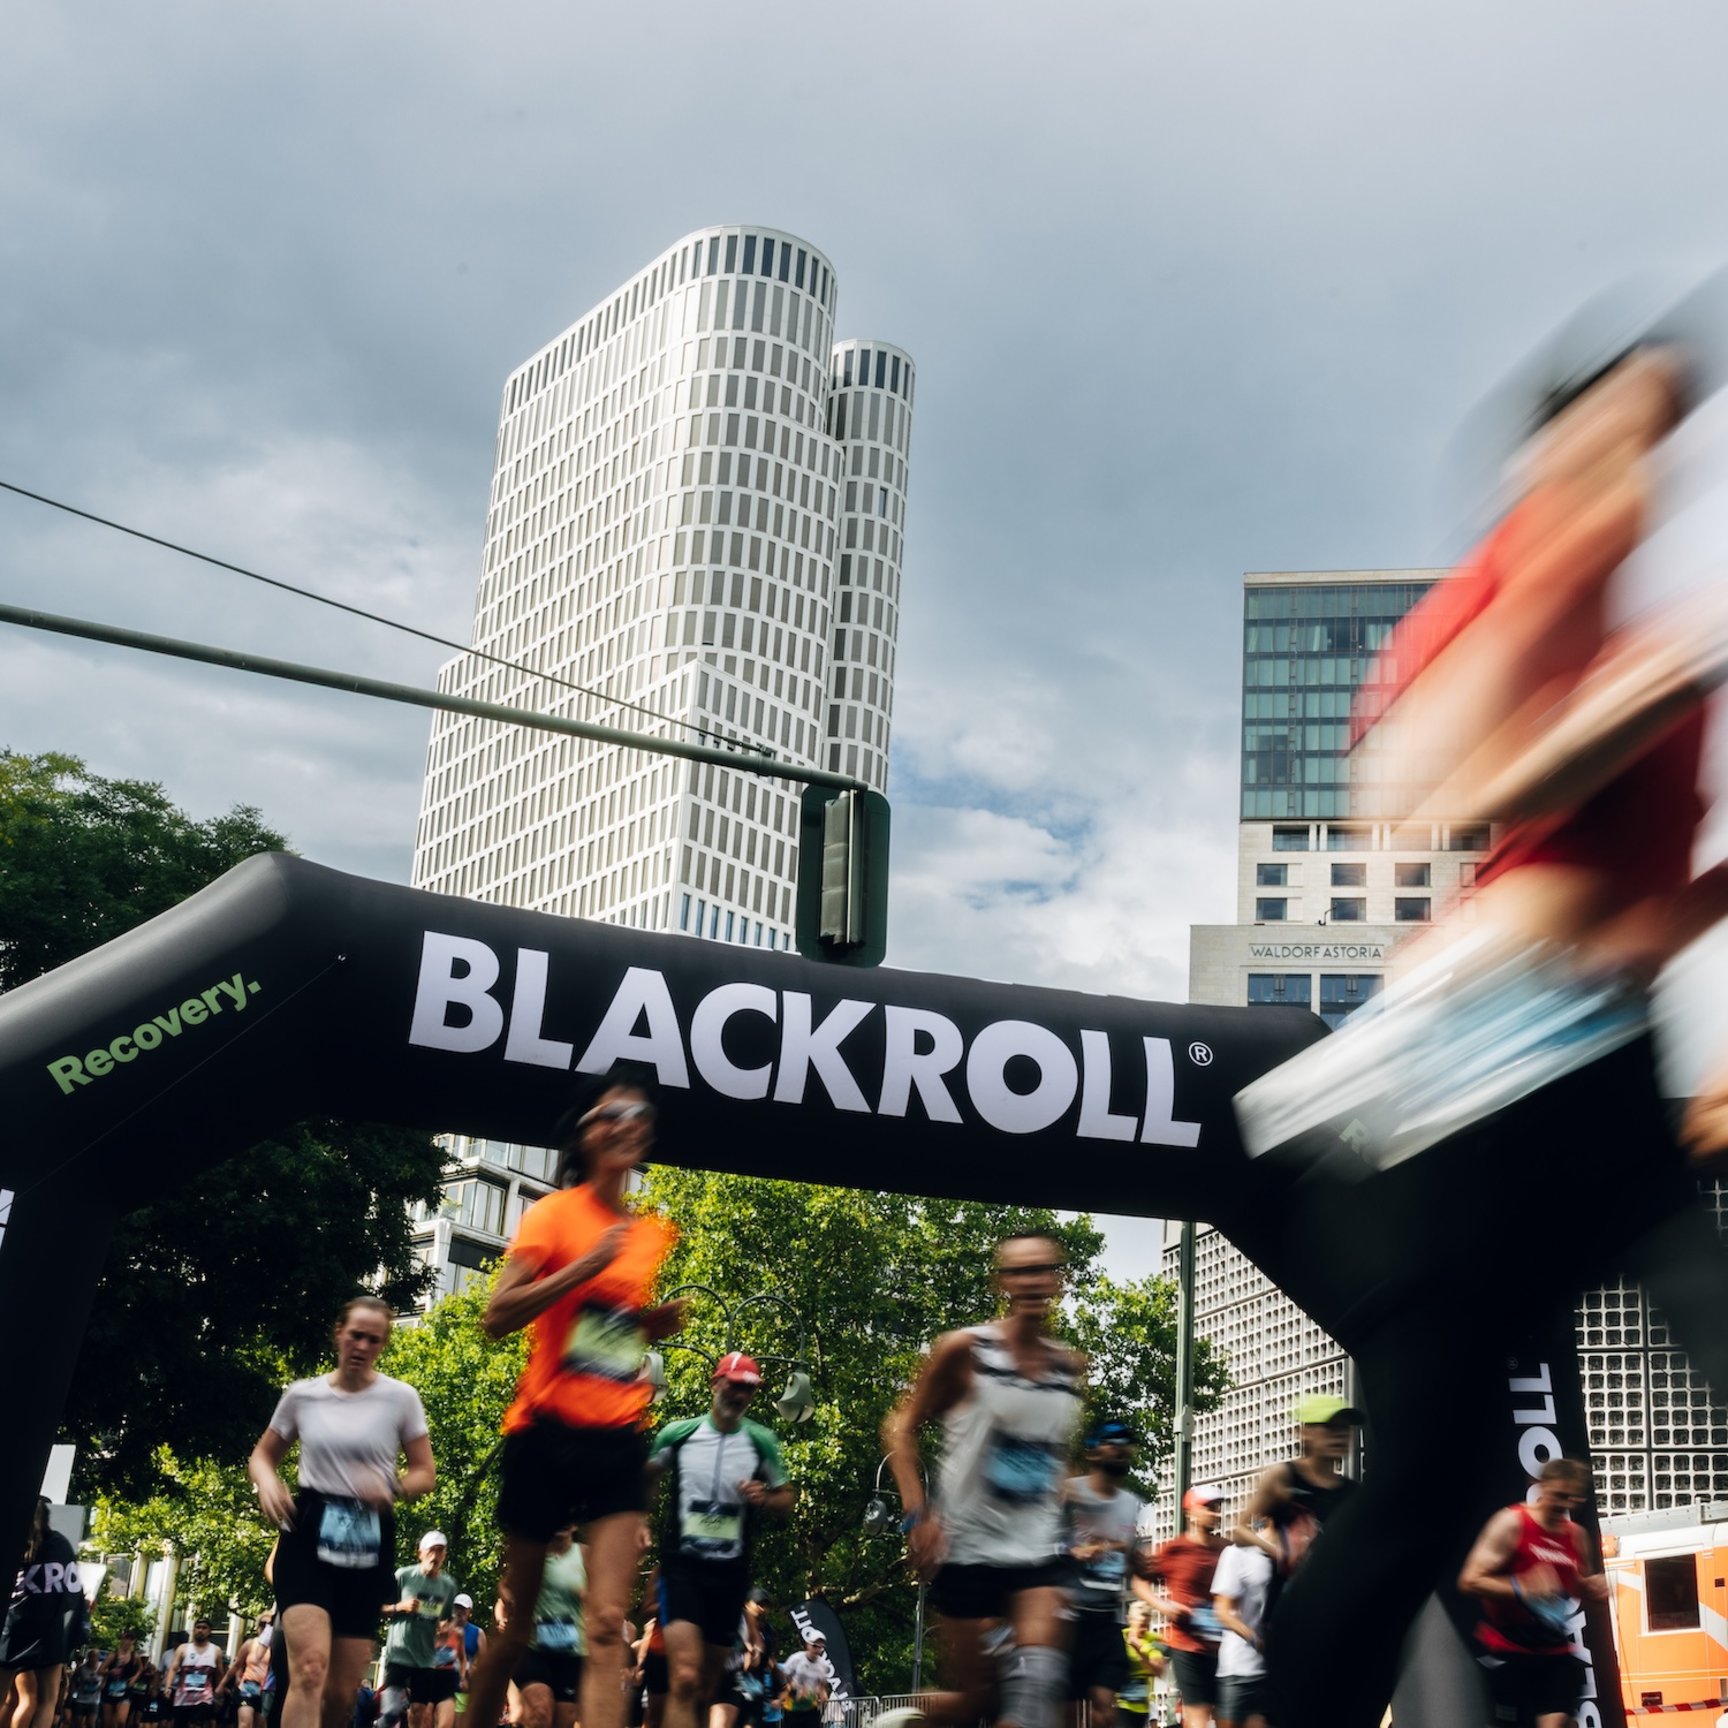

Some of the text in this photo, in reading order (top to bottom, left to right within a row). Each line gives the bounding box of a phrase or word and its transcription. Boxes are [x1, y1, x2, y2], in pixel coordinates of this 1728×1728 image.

[1250, 946, 1382, 959] WALDORF ASTORIA
[46, 972, 262, 1095] Recovery.
